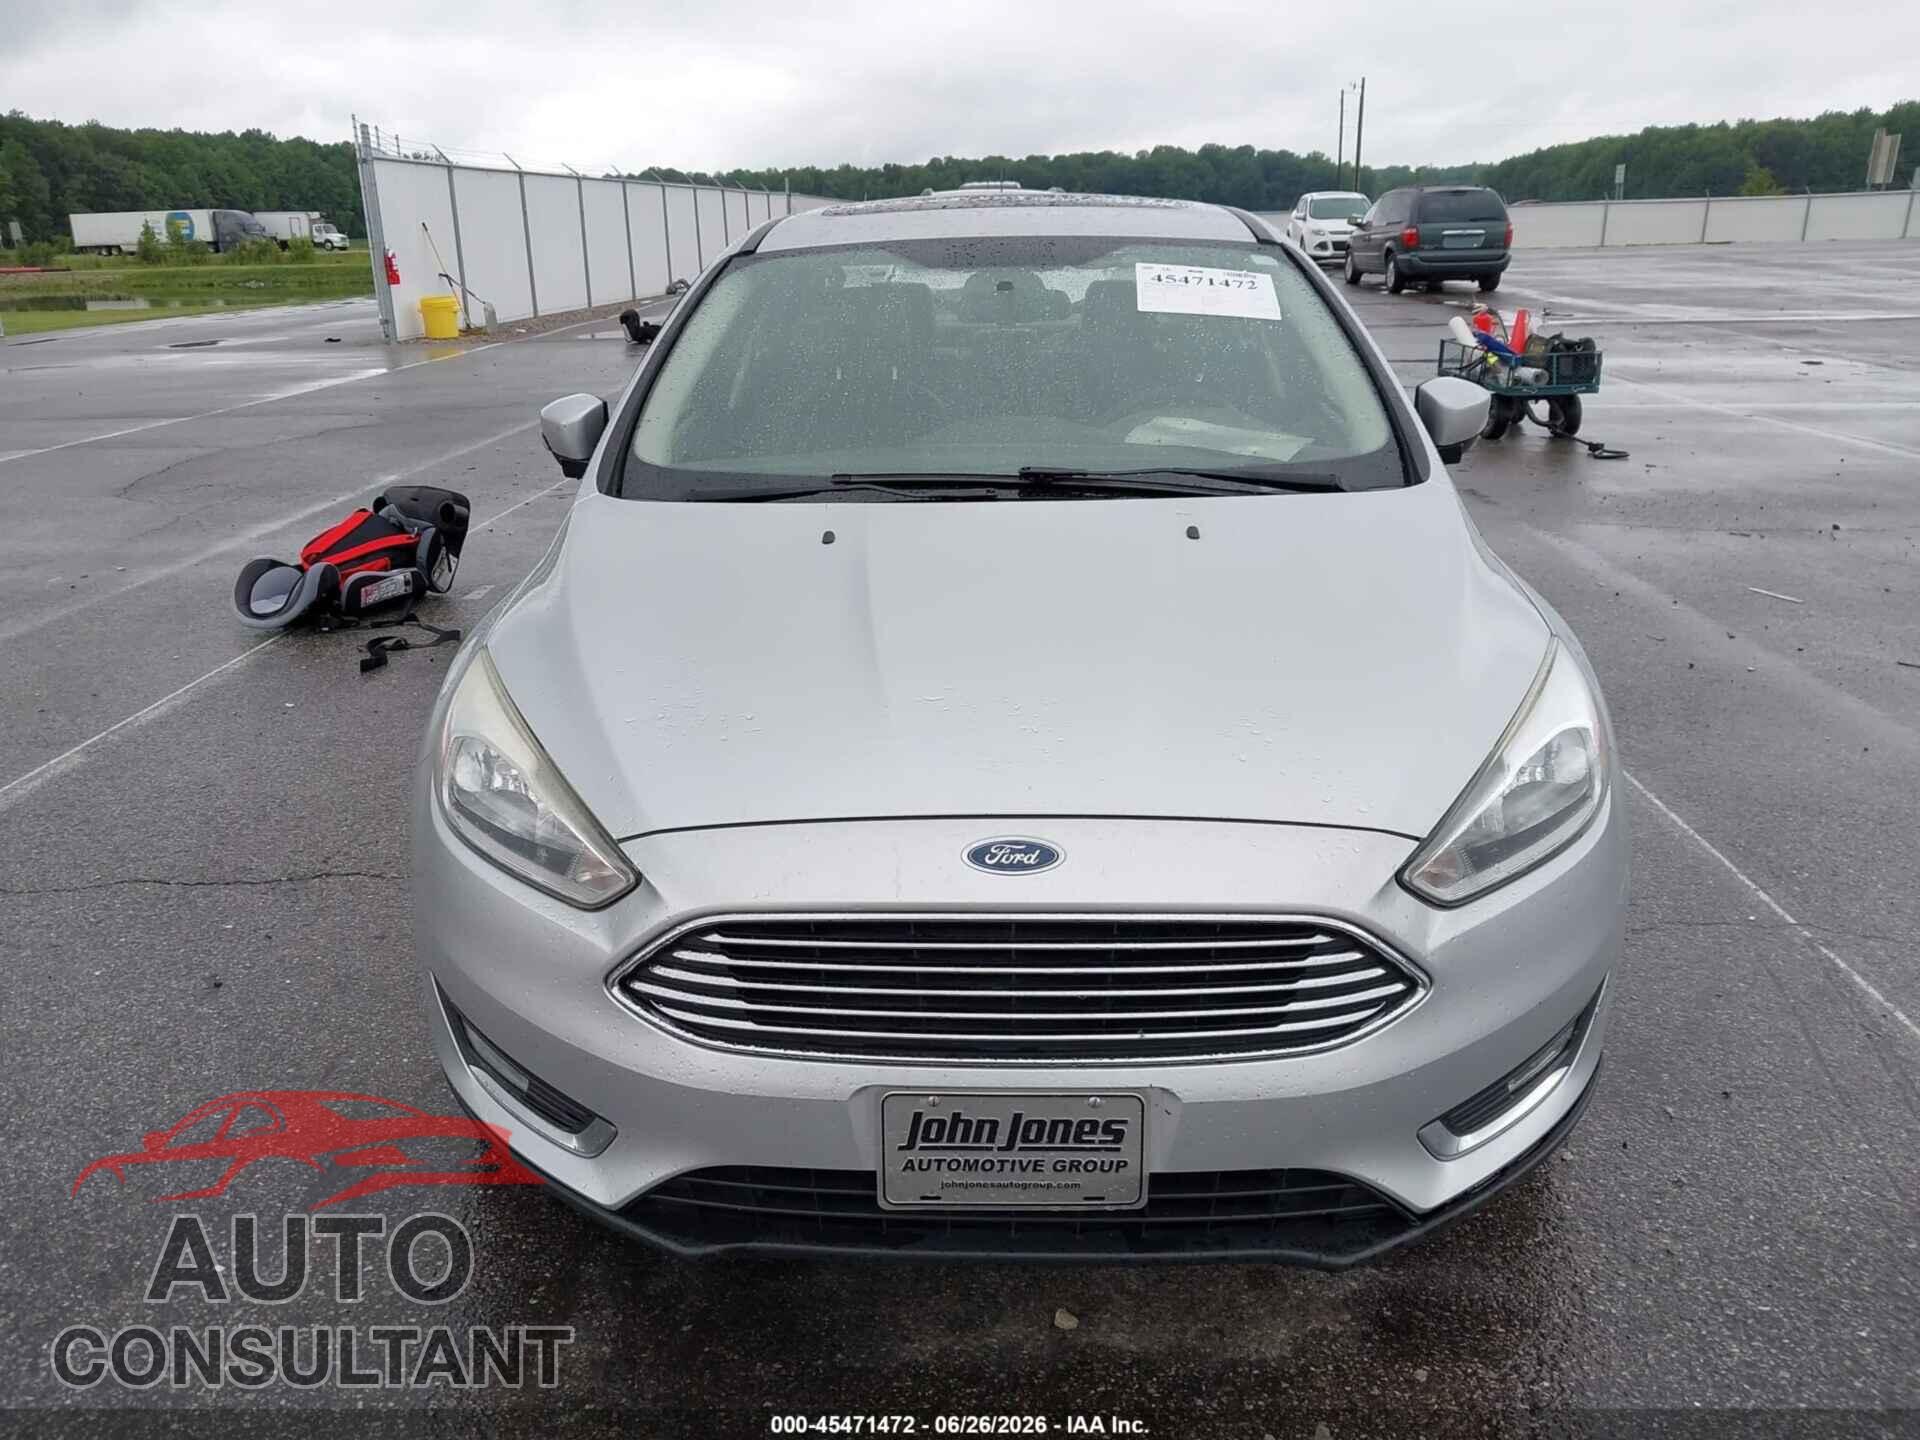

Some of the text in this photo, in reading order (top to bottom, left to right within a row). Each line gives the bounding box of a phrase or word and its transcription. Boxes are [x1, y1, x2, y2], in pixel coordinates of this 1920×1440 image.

[1151, 272, 1258, 290] 45471472
[985, 844, 1040, 864] Ford
[897, 1112, 1128, 1152] John Jones
[902, 1158, 1128, 1174] AUTOMOTIVE GROUP
[941, 1180, 1081, 1191] johnjonesautogroup.com
